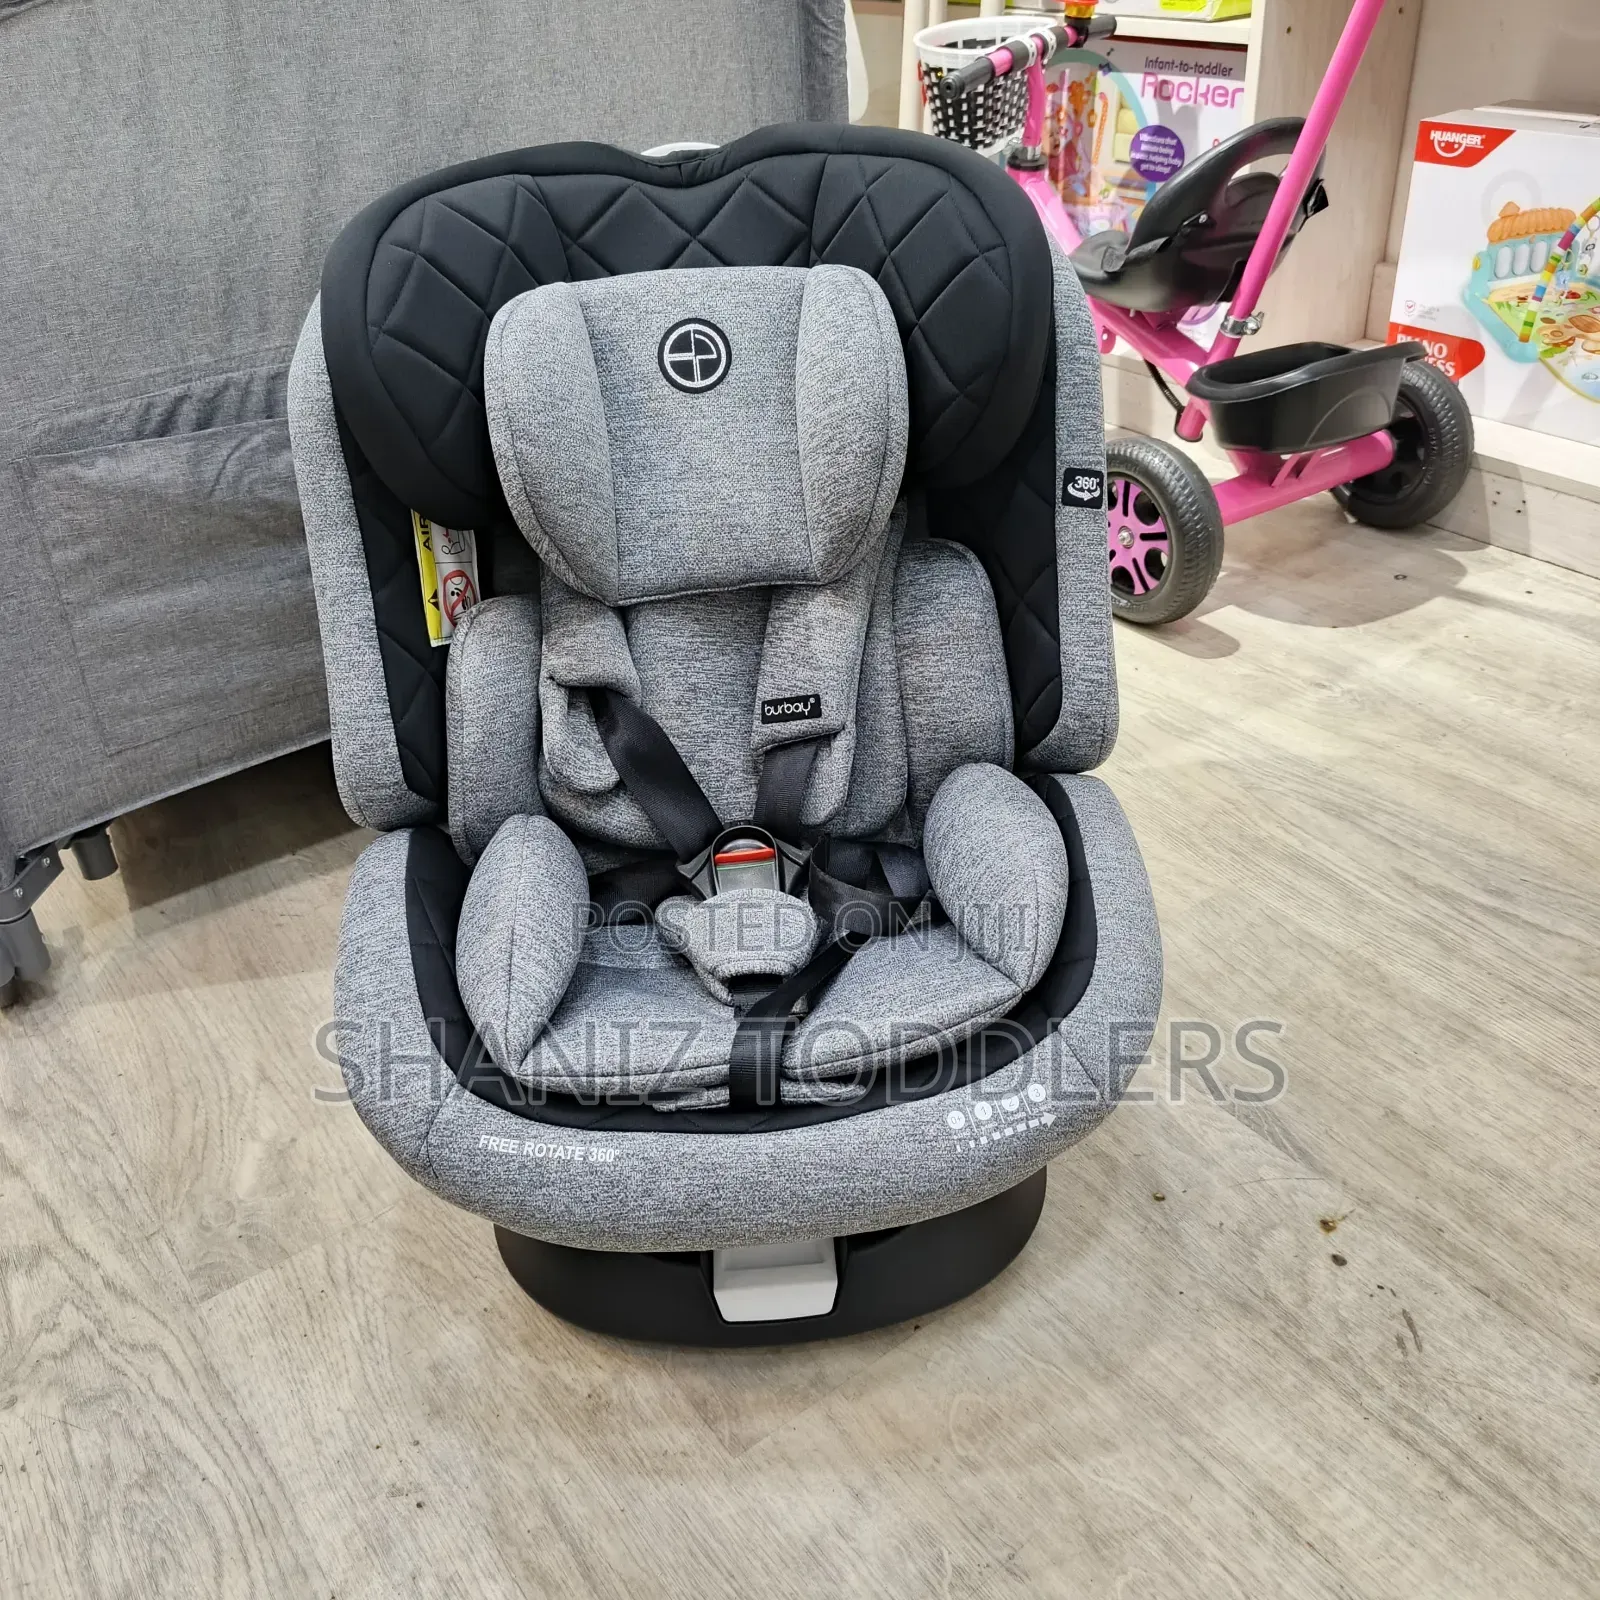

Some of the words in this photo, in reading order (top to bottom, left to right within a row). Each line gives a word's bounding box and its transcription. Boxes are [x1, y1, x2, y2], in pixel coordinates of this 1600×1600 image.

[1144, 56, 1234, 77] Infant-to-toddler
[1141, 72, 1245, 109] Rocker
[1430, 130, 1482, 146] HUANGER
[478, 1134, 520, 1154] FREE
[522, 1141, 586, 1161] ROTATE
